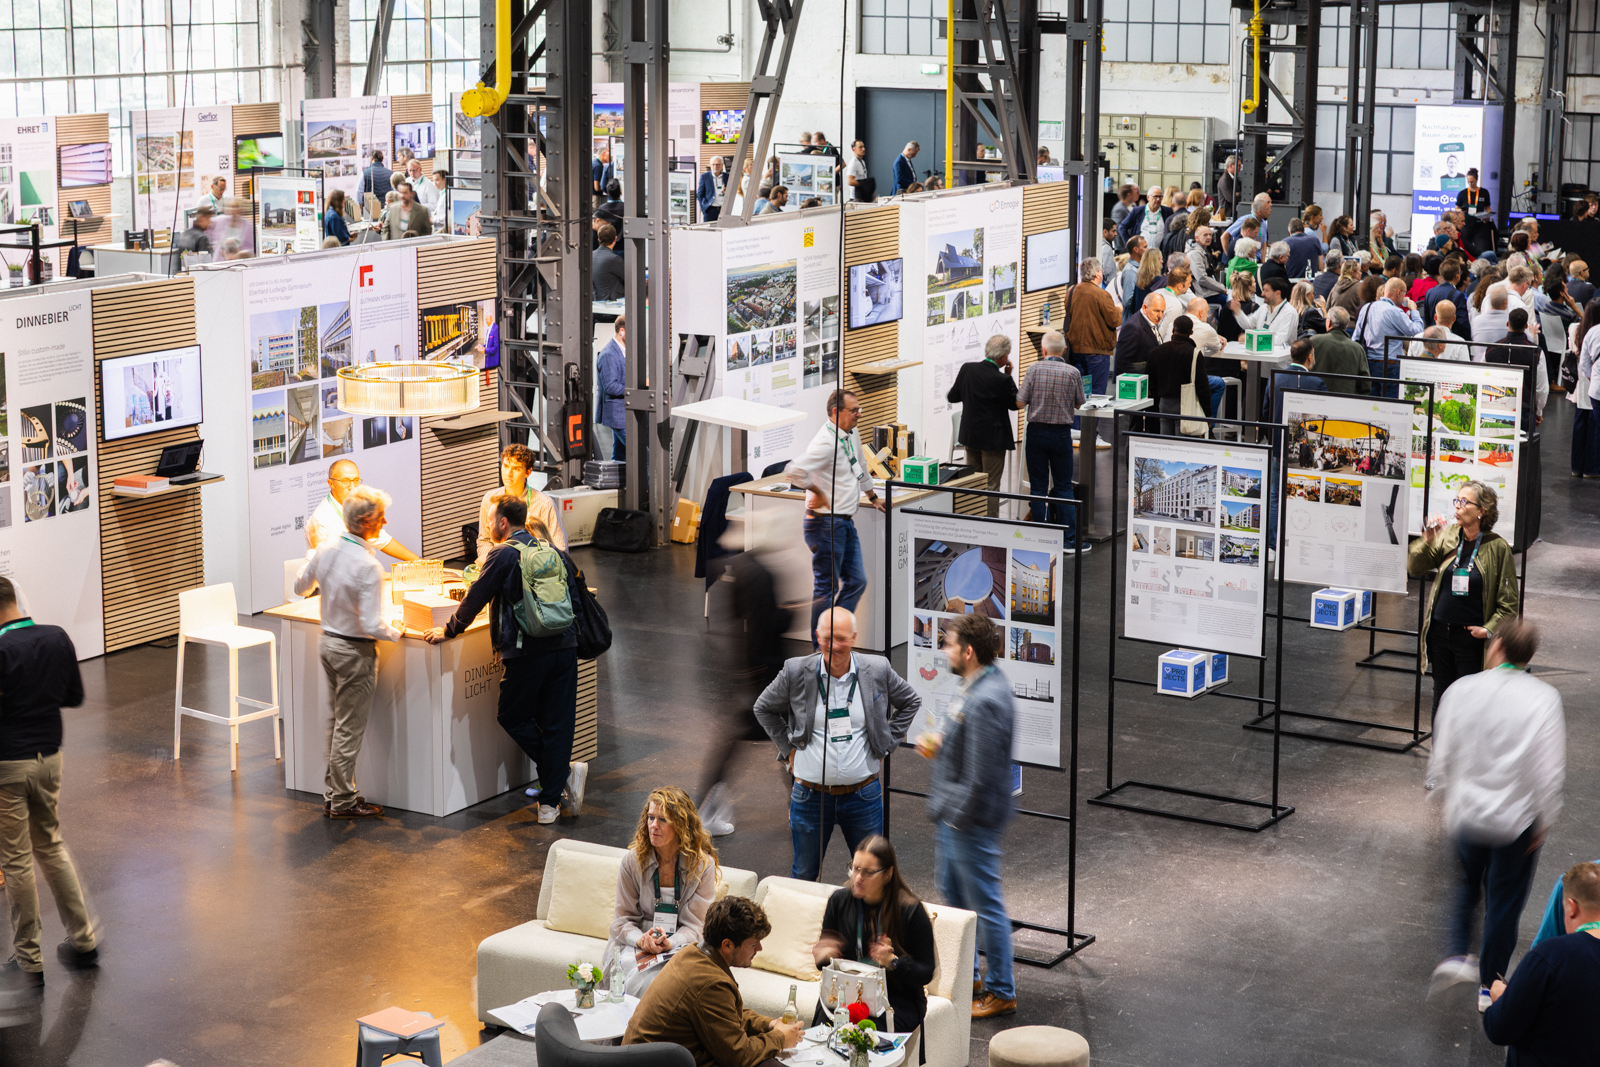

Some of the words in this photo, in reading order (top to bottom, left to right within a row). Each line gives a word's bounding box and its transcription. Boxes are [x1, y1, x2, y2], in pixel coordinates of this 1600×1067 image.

[18, 126, 40, 134] EHRET
[1001, 200, 1019, 209] Ennogie
[249, 283, 312, 296] Eberhard-Ludwigs-Gymnasium
[360, 296, 380, 304] GUTMANN
[16, 311, 69, 329] DINNEBIER
[31, 344, 65, 355] custom-made
[899, 531, 908, 543] GU
[898, 557, 908, 569] GM
[465, 662, 504, 683] DINNEBI
[1213, 664, 1225, 672] JECTS
[1164, 674, 1185, 682] JECTS
[465, 679, 492, 699] LICHT
